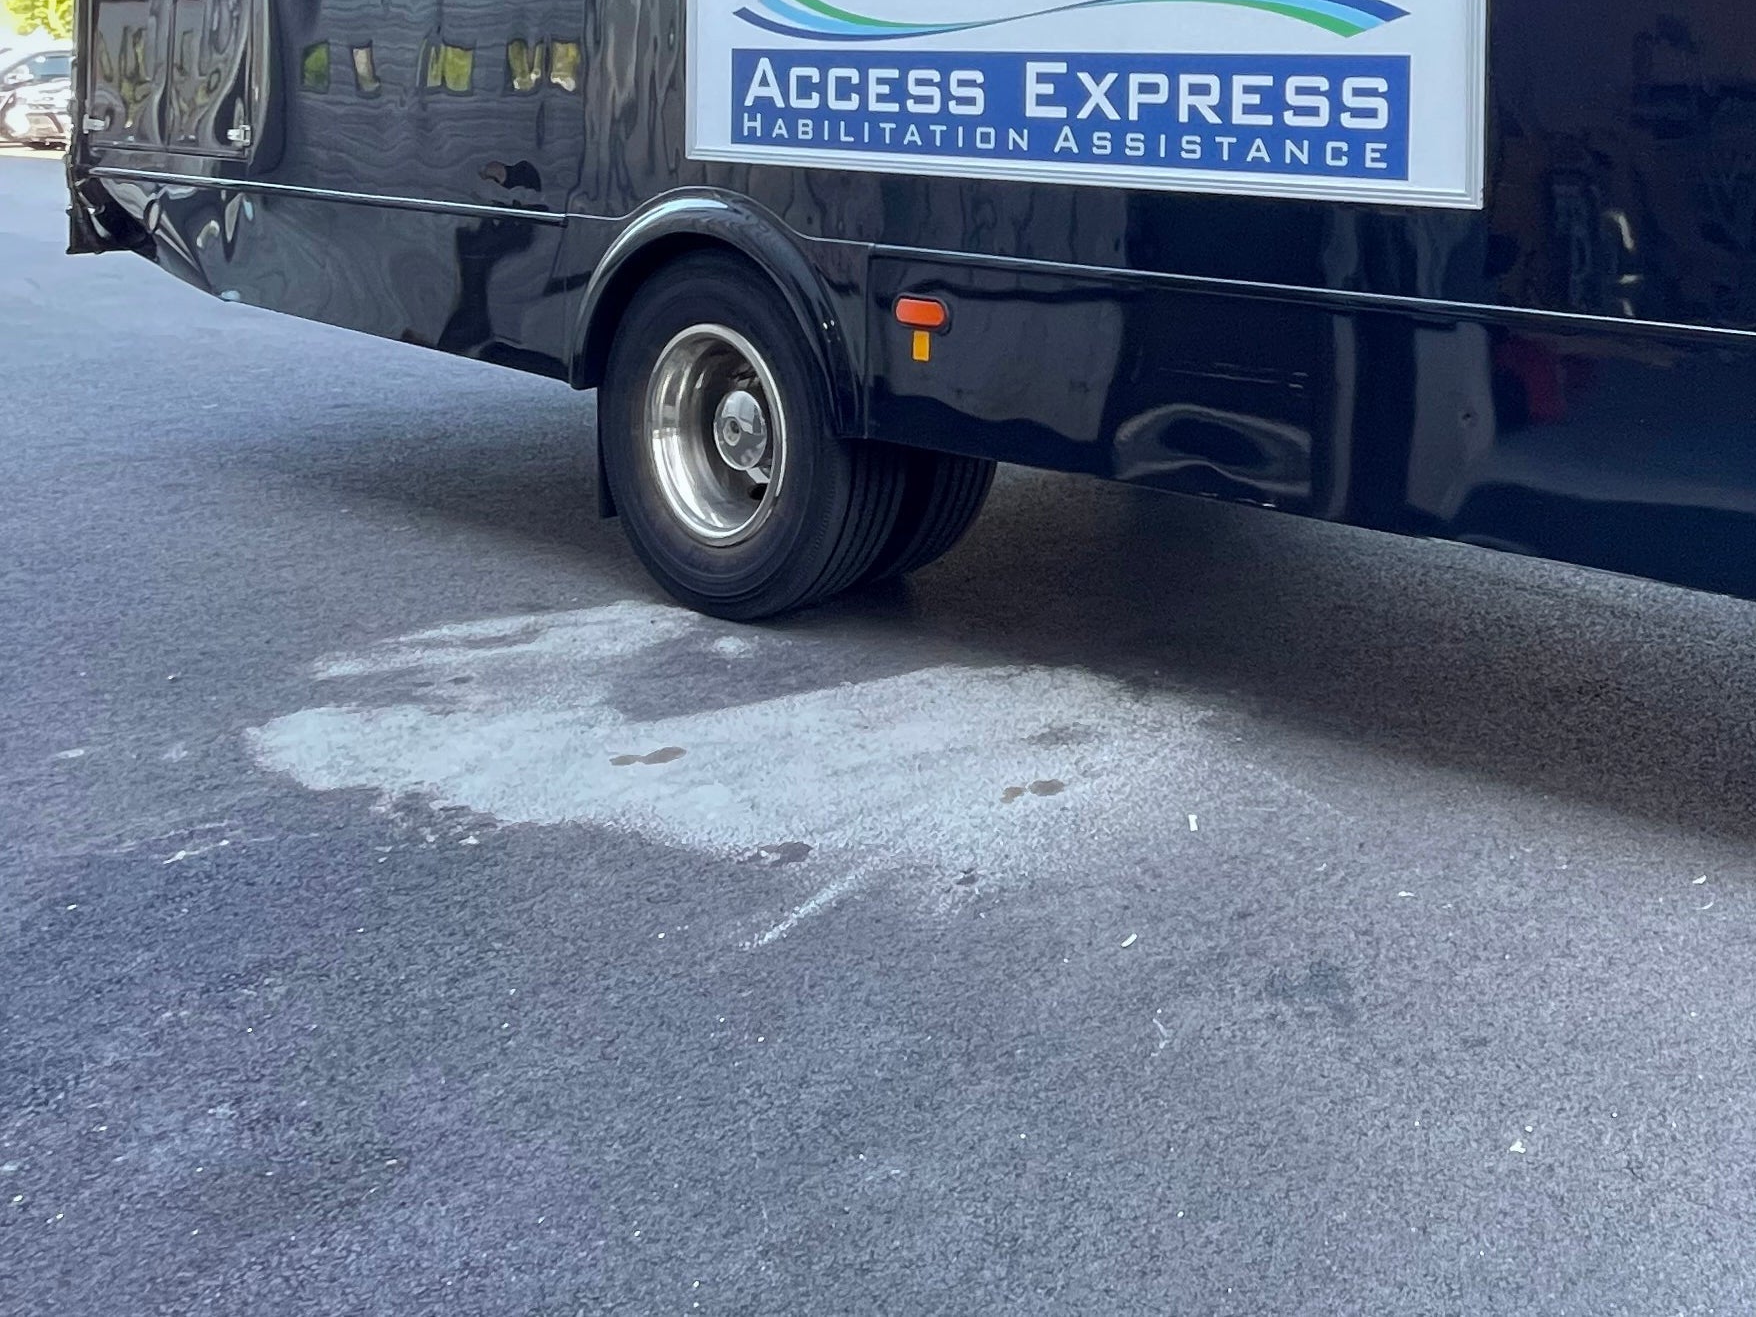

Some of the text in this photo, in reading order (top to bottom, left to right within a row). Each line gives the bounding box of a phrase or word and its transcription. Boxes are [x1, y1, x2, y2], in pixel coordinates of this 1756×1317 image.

[744, 57, 1388, 129] ACCESS EXPRESS
[744, 113, 1387, 168] HABILITATION ASSISTANCE
